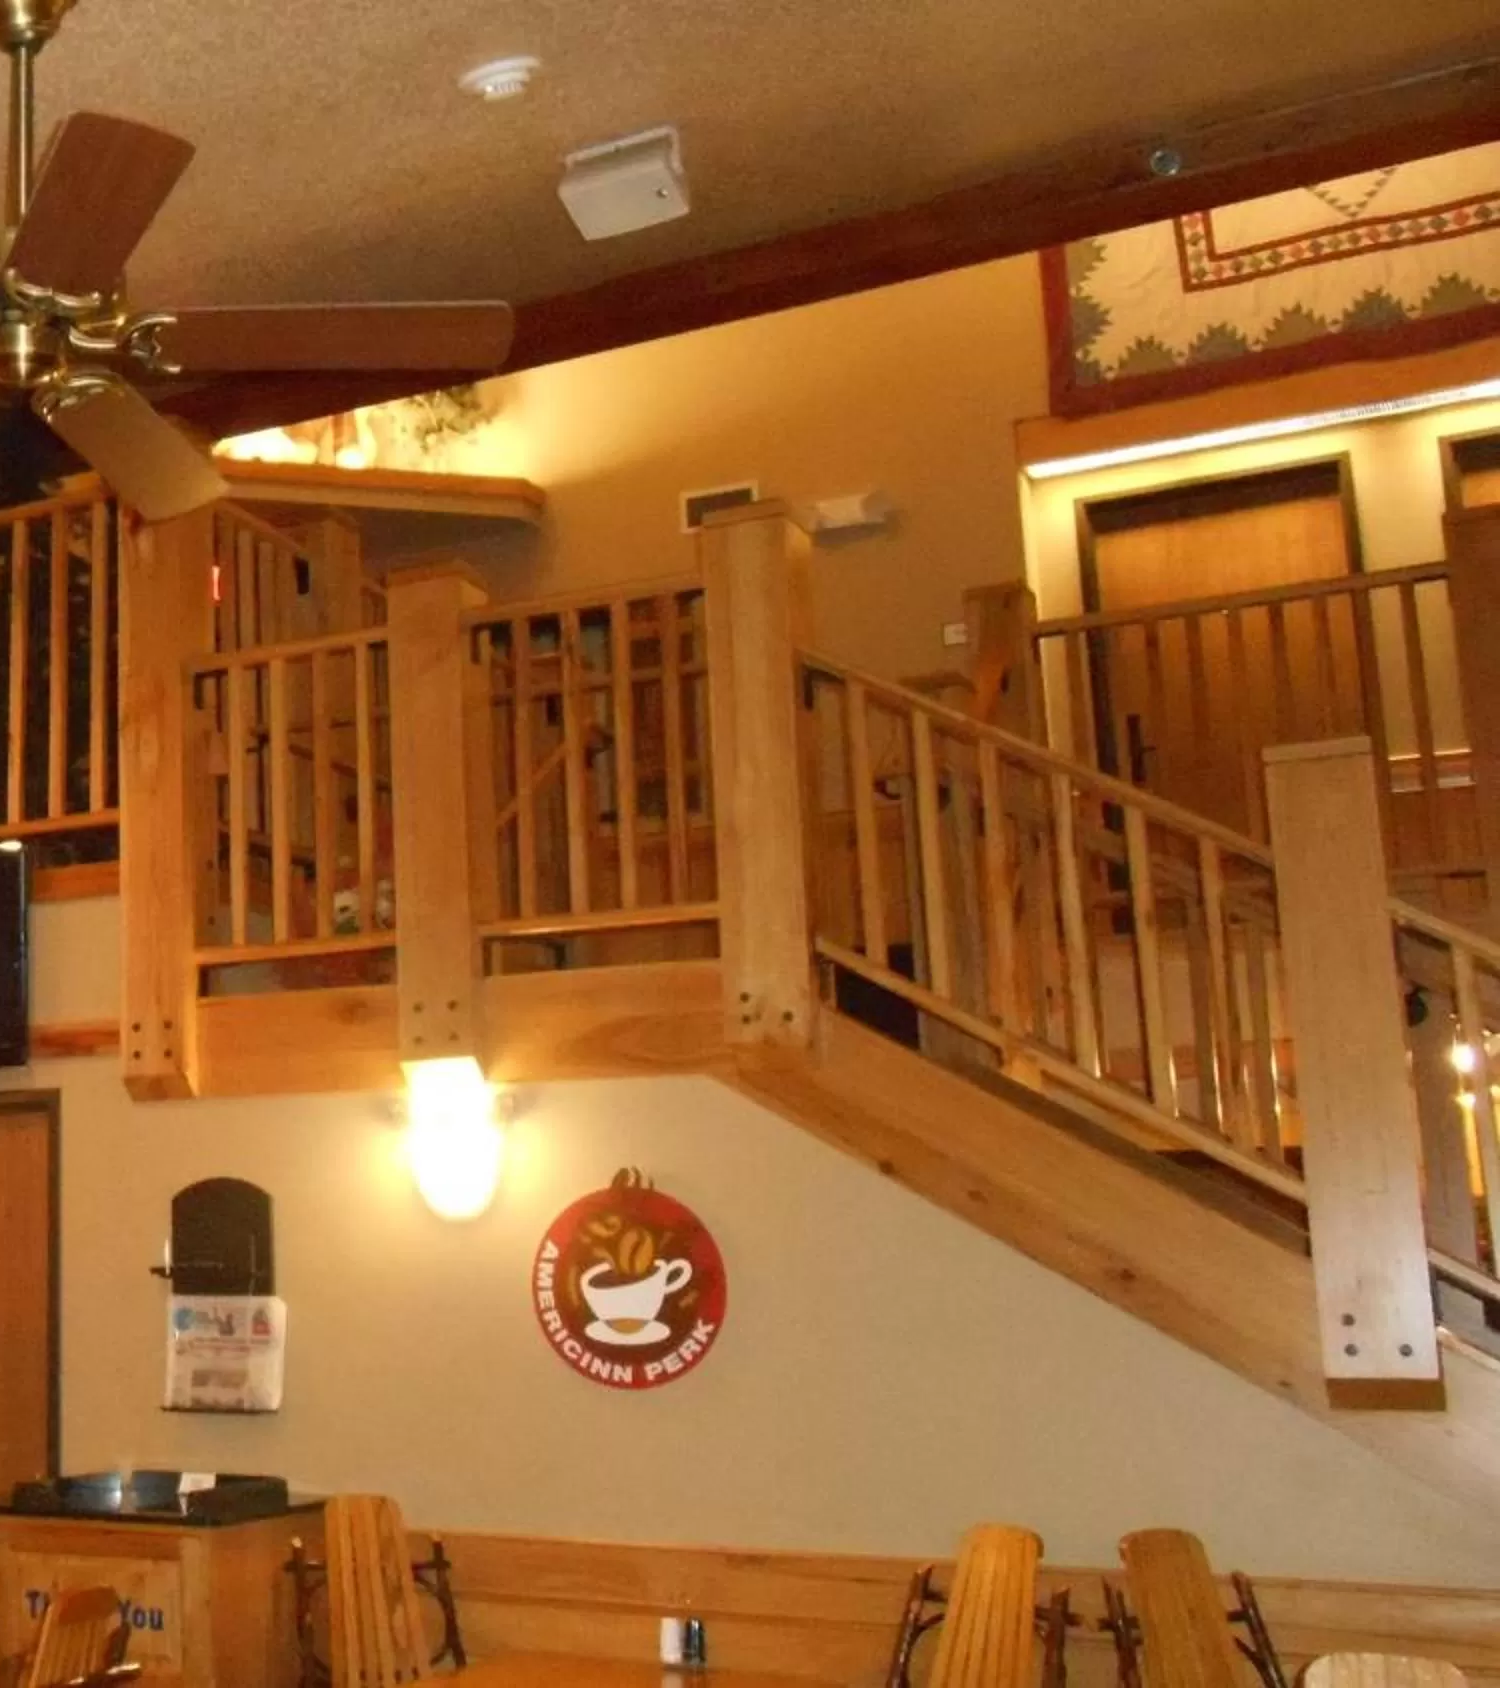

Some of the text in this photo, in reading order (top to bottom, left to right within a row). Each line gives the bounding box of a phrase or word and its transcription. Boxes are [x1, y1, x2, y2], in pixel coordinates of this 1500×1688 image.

[537, 1240, 716, 1383] AMERICINN PERK
[117, 1599, 165, 1631] You
